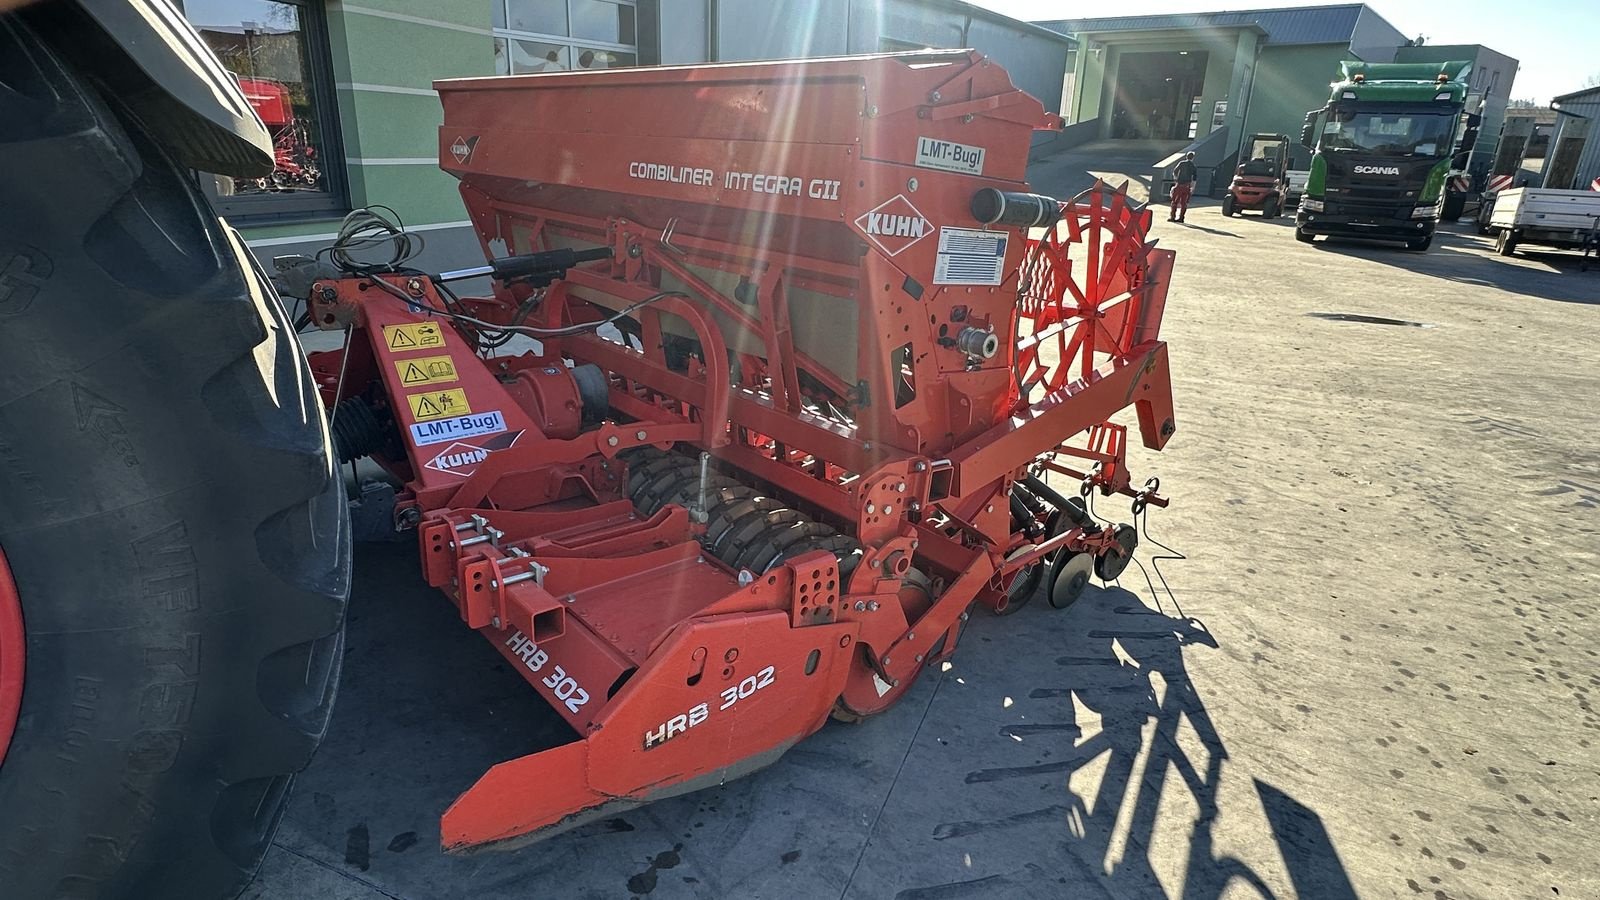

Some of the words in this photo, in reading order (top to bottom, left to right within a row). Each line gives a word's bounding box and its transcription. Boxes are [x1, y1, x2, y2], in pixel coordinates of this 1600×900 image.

[921, 138, 982, 168] LMT-Bugl
[629, 161, 714, 187] COMBILINER
[724, 171, 803, 197] INTEGRA
[808, 178, 841, 201] GII
[1353, 165, 1400, 176] SCANIA
[866, 212, 925, 238] KUHN
[416, 412, 500, 437] LMT-Bugl
[505, 630, 549, 672] HRB
[541, 665, 590, 714] 302
[644, 702, 709, 748] HRB
[720, 665, 775, 711] 302
